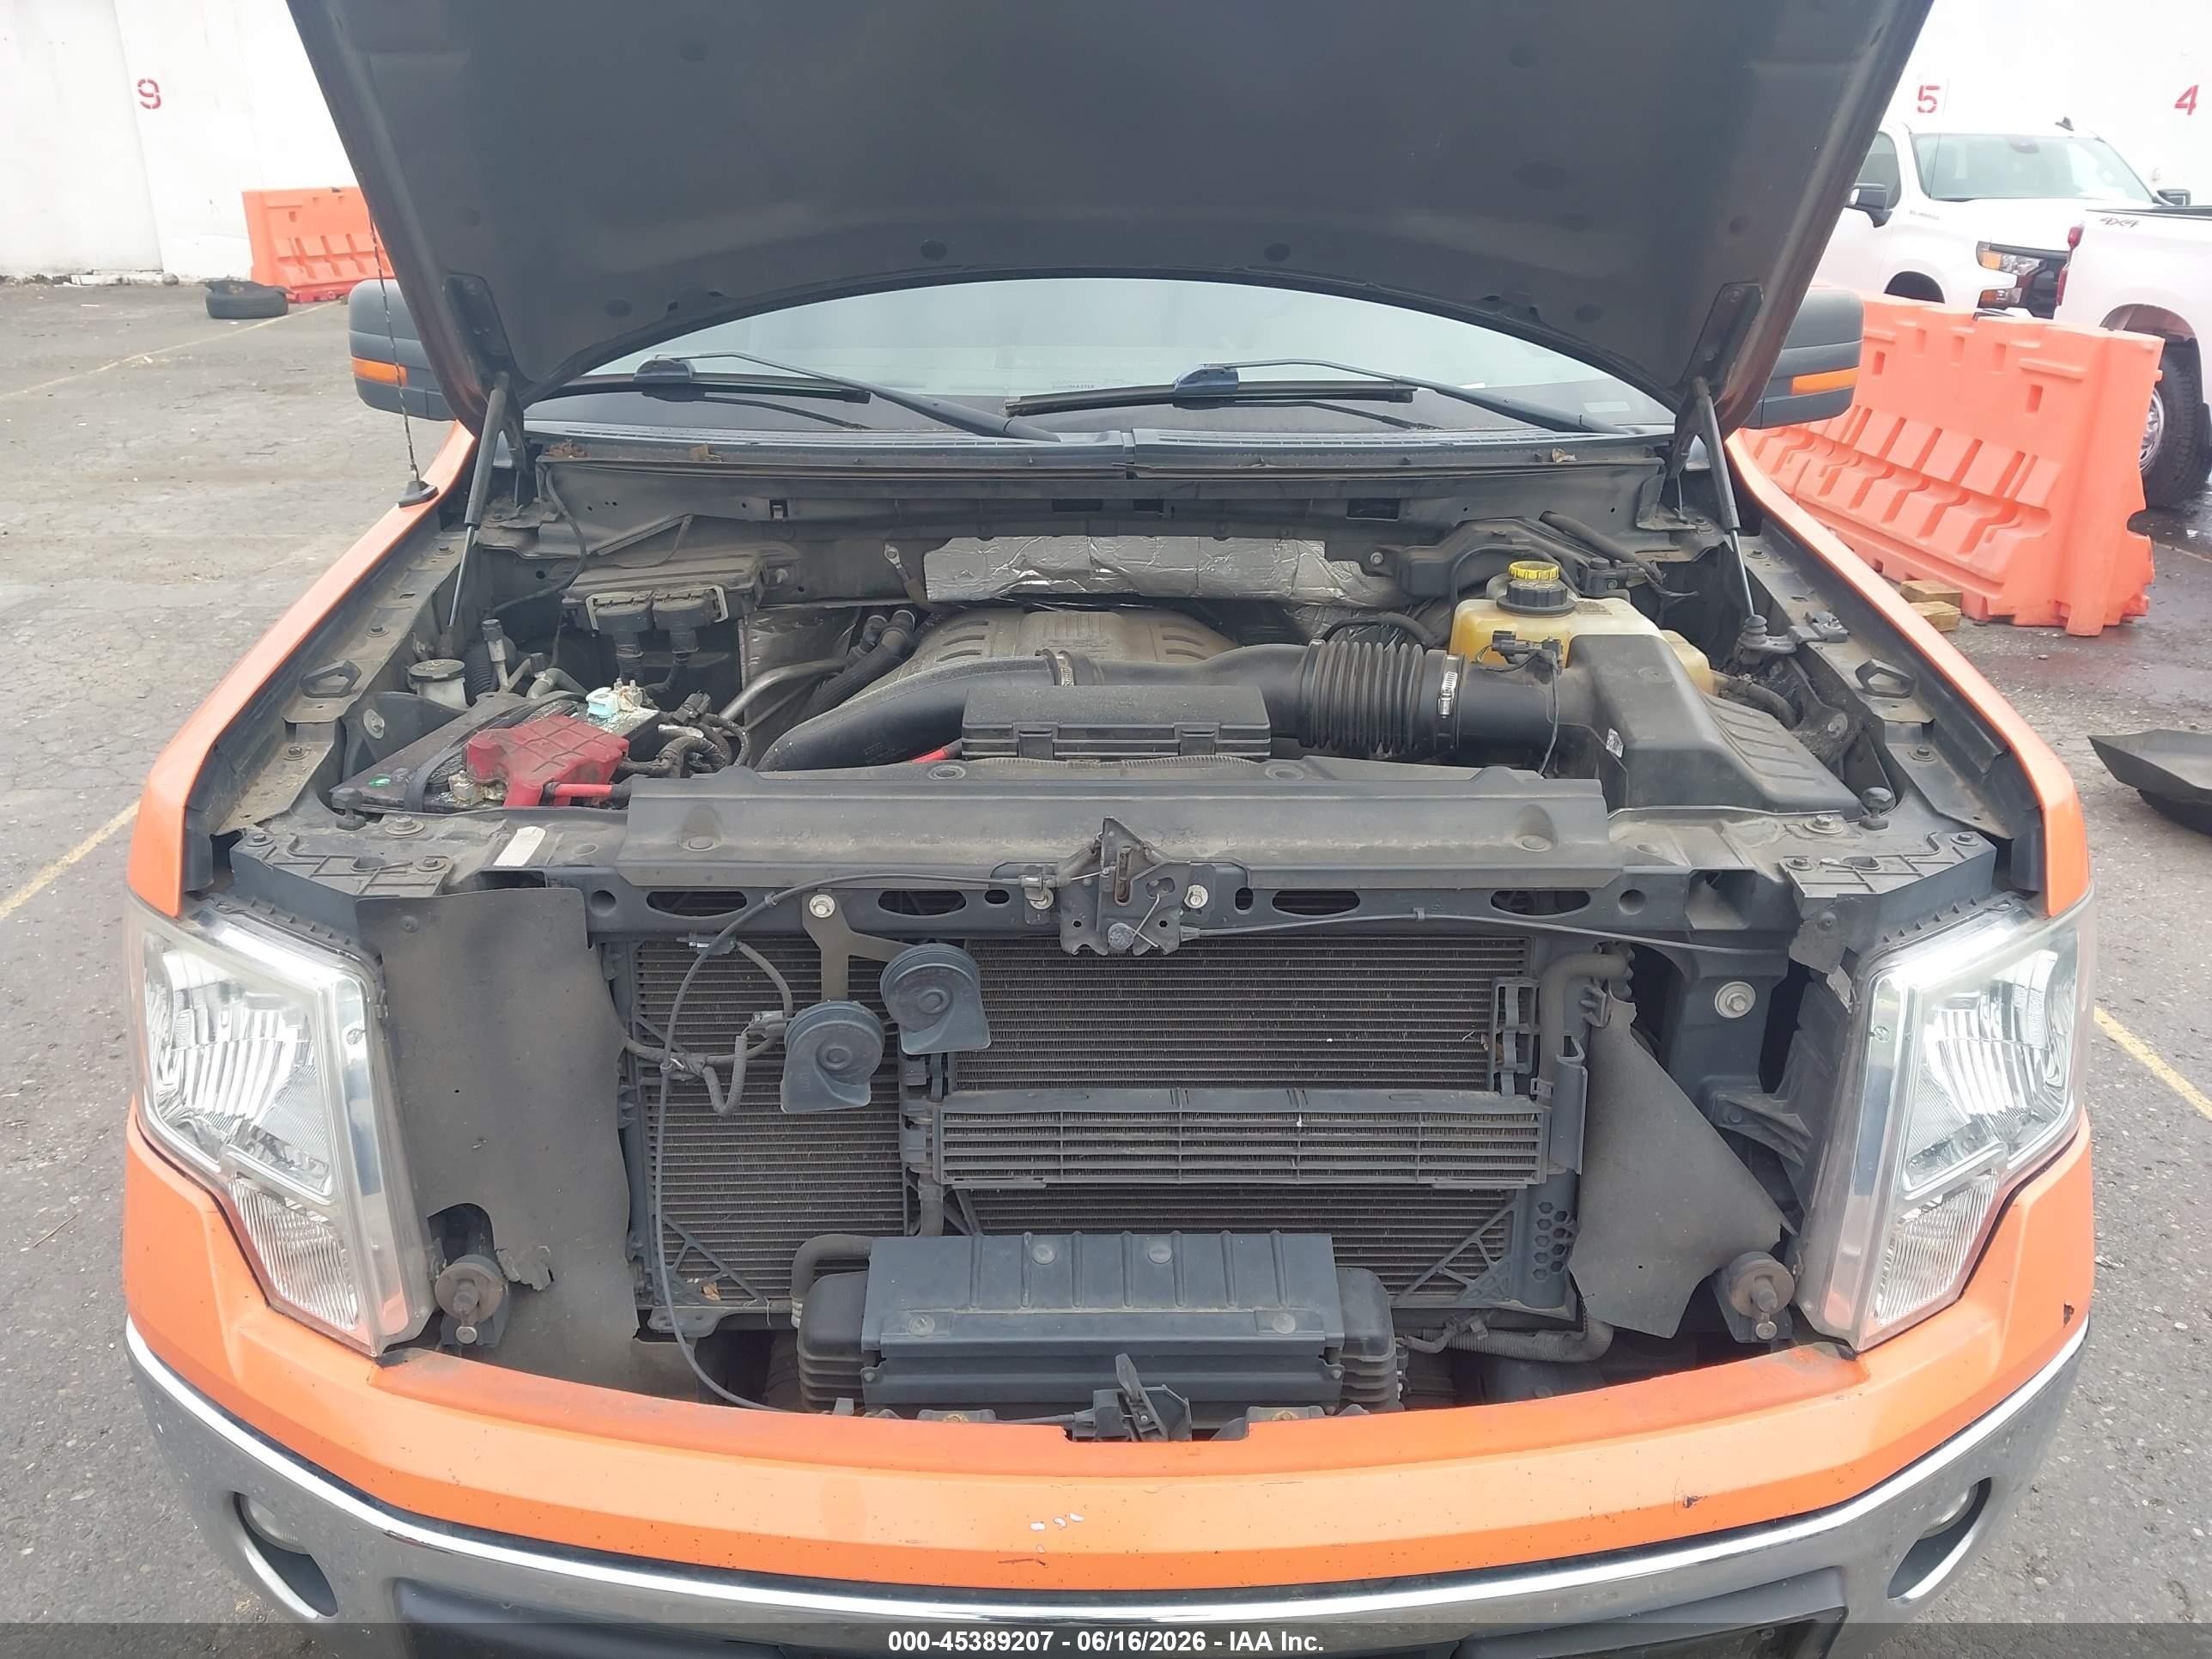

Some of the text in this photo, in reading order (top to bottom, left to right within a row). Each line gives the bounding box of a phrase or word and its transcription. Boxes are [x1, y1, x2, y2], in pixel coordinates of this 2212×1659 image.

[137, 78, 161, 109] 9
[1917, 85, 1941, 113] 5
[2174, 84, 2199, 116] 4
